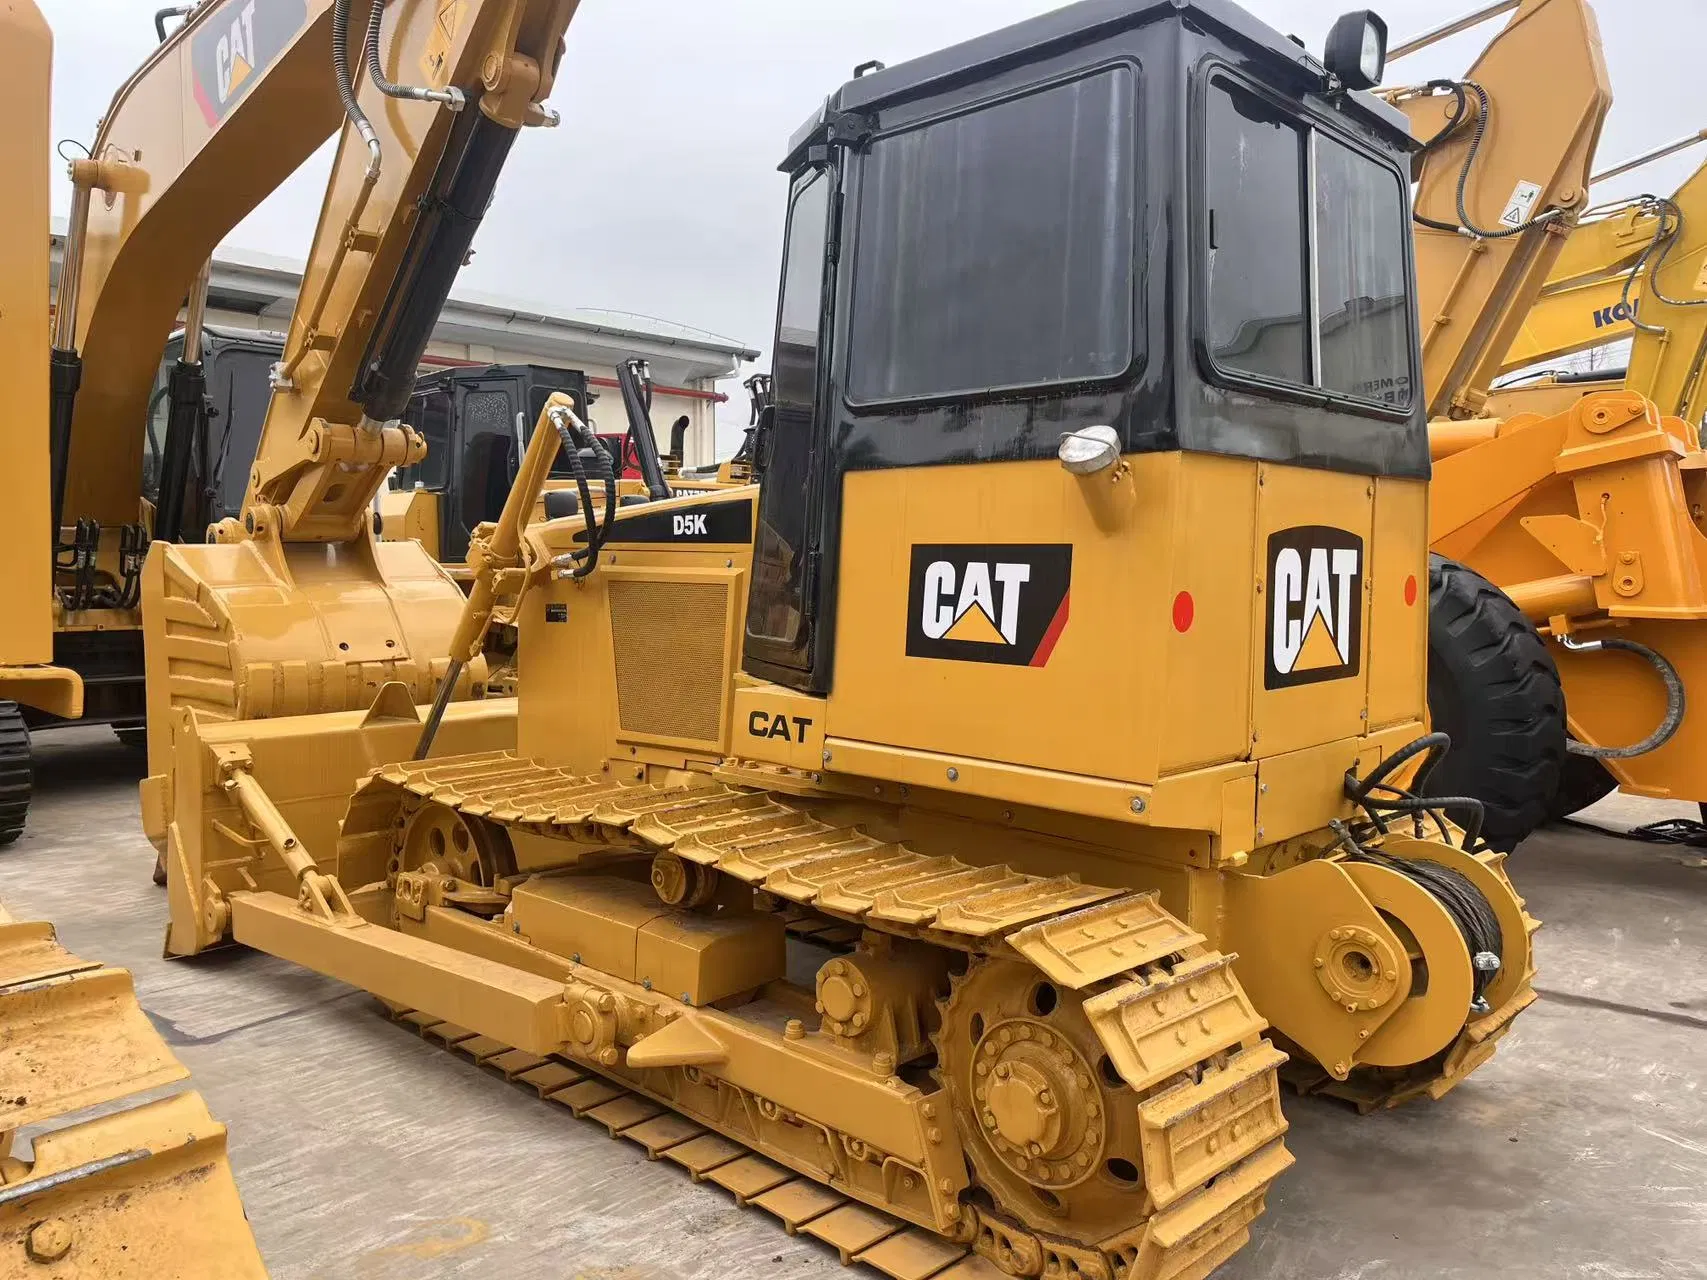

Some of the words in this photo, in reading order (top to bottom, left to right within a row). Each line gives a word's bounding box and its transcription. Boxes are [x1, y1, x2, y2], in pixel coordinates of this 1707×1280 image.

[216, 0, 255, 104] CAT
[1593, 298, 1639, 328] KO
[673, 514, 707, 535] D5K
[922, 561, 1030, 645] CAT
[1273, 548, 1358, 674] CAT
[749, 711, 812, 743] CAT
